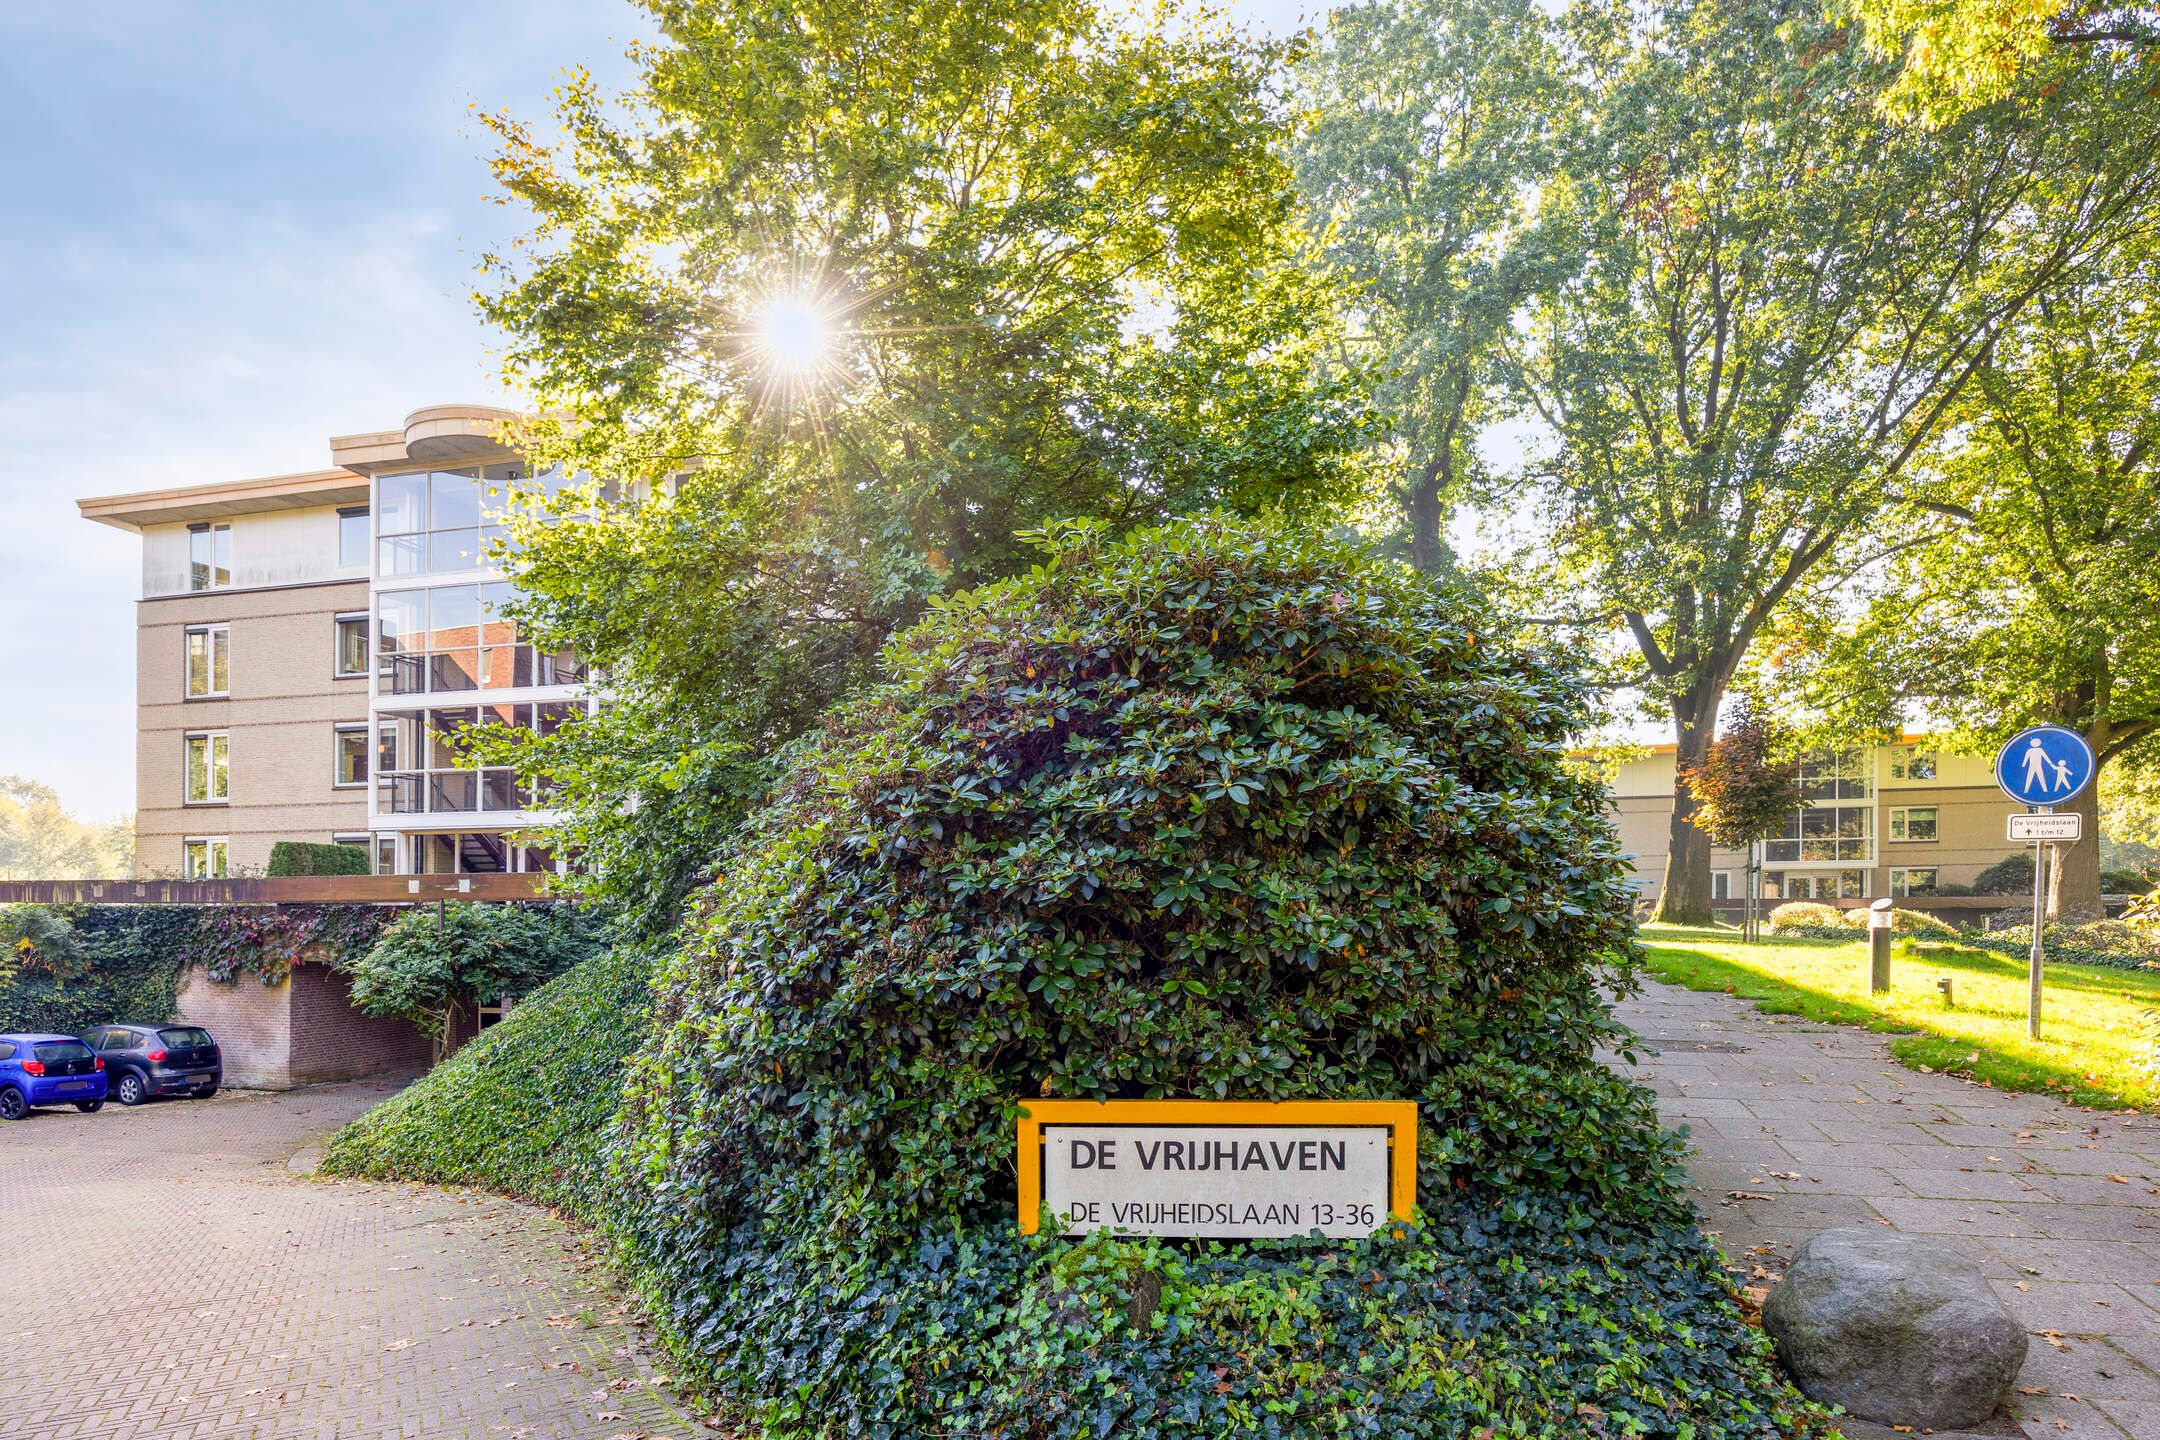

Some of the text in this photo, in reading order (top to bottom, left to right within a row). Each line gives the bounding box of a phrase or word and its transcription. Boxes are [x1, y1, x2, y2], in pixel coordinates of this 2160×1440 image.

[1070, 1140, 1346, 1171] DE VRIJHAVEN
[1071, 1202, 1375, 1225] DE VRIJHEIDSLAAN 13-36
